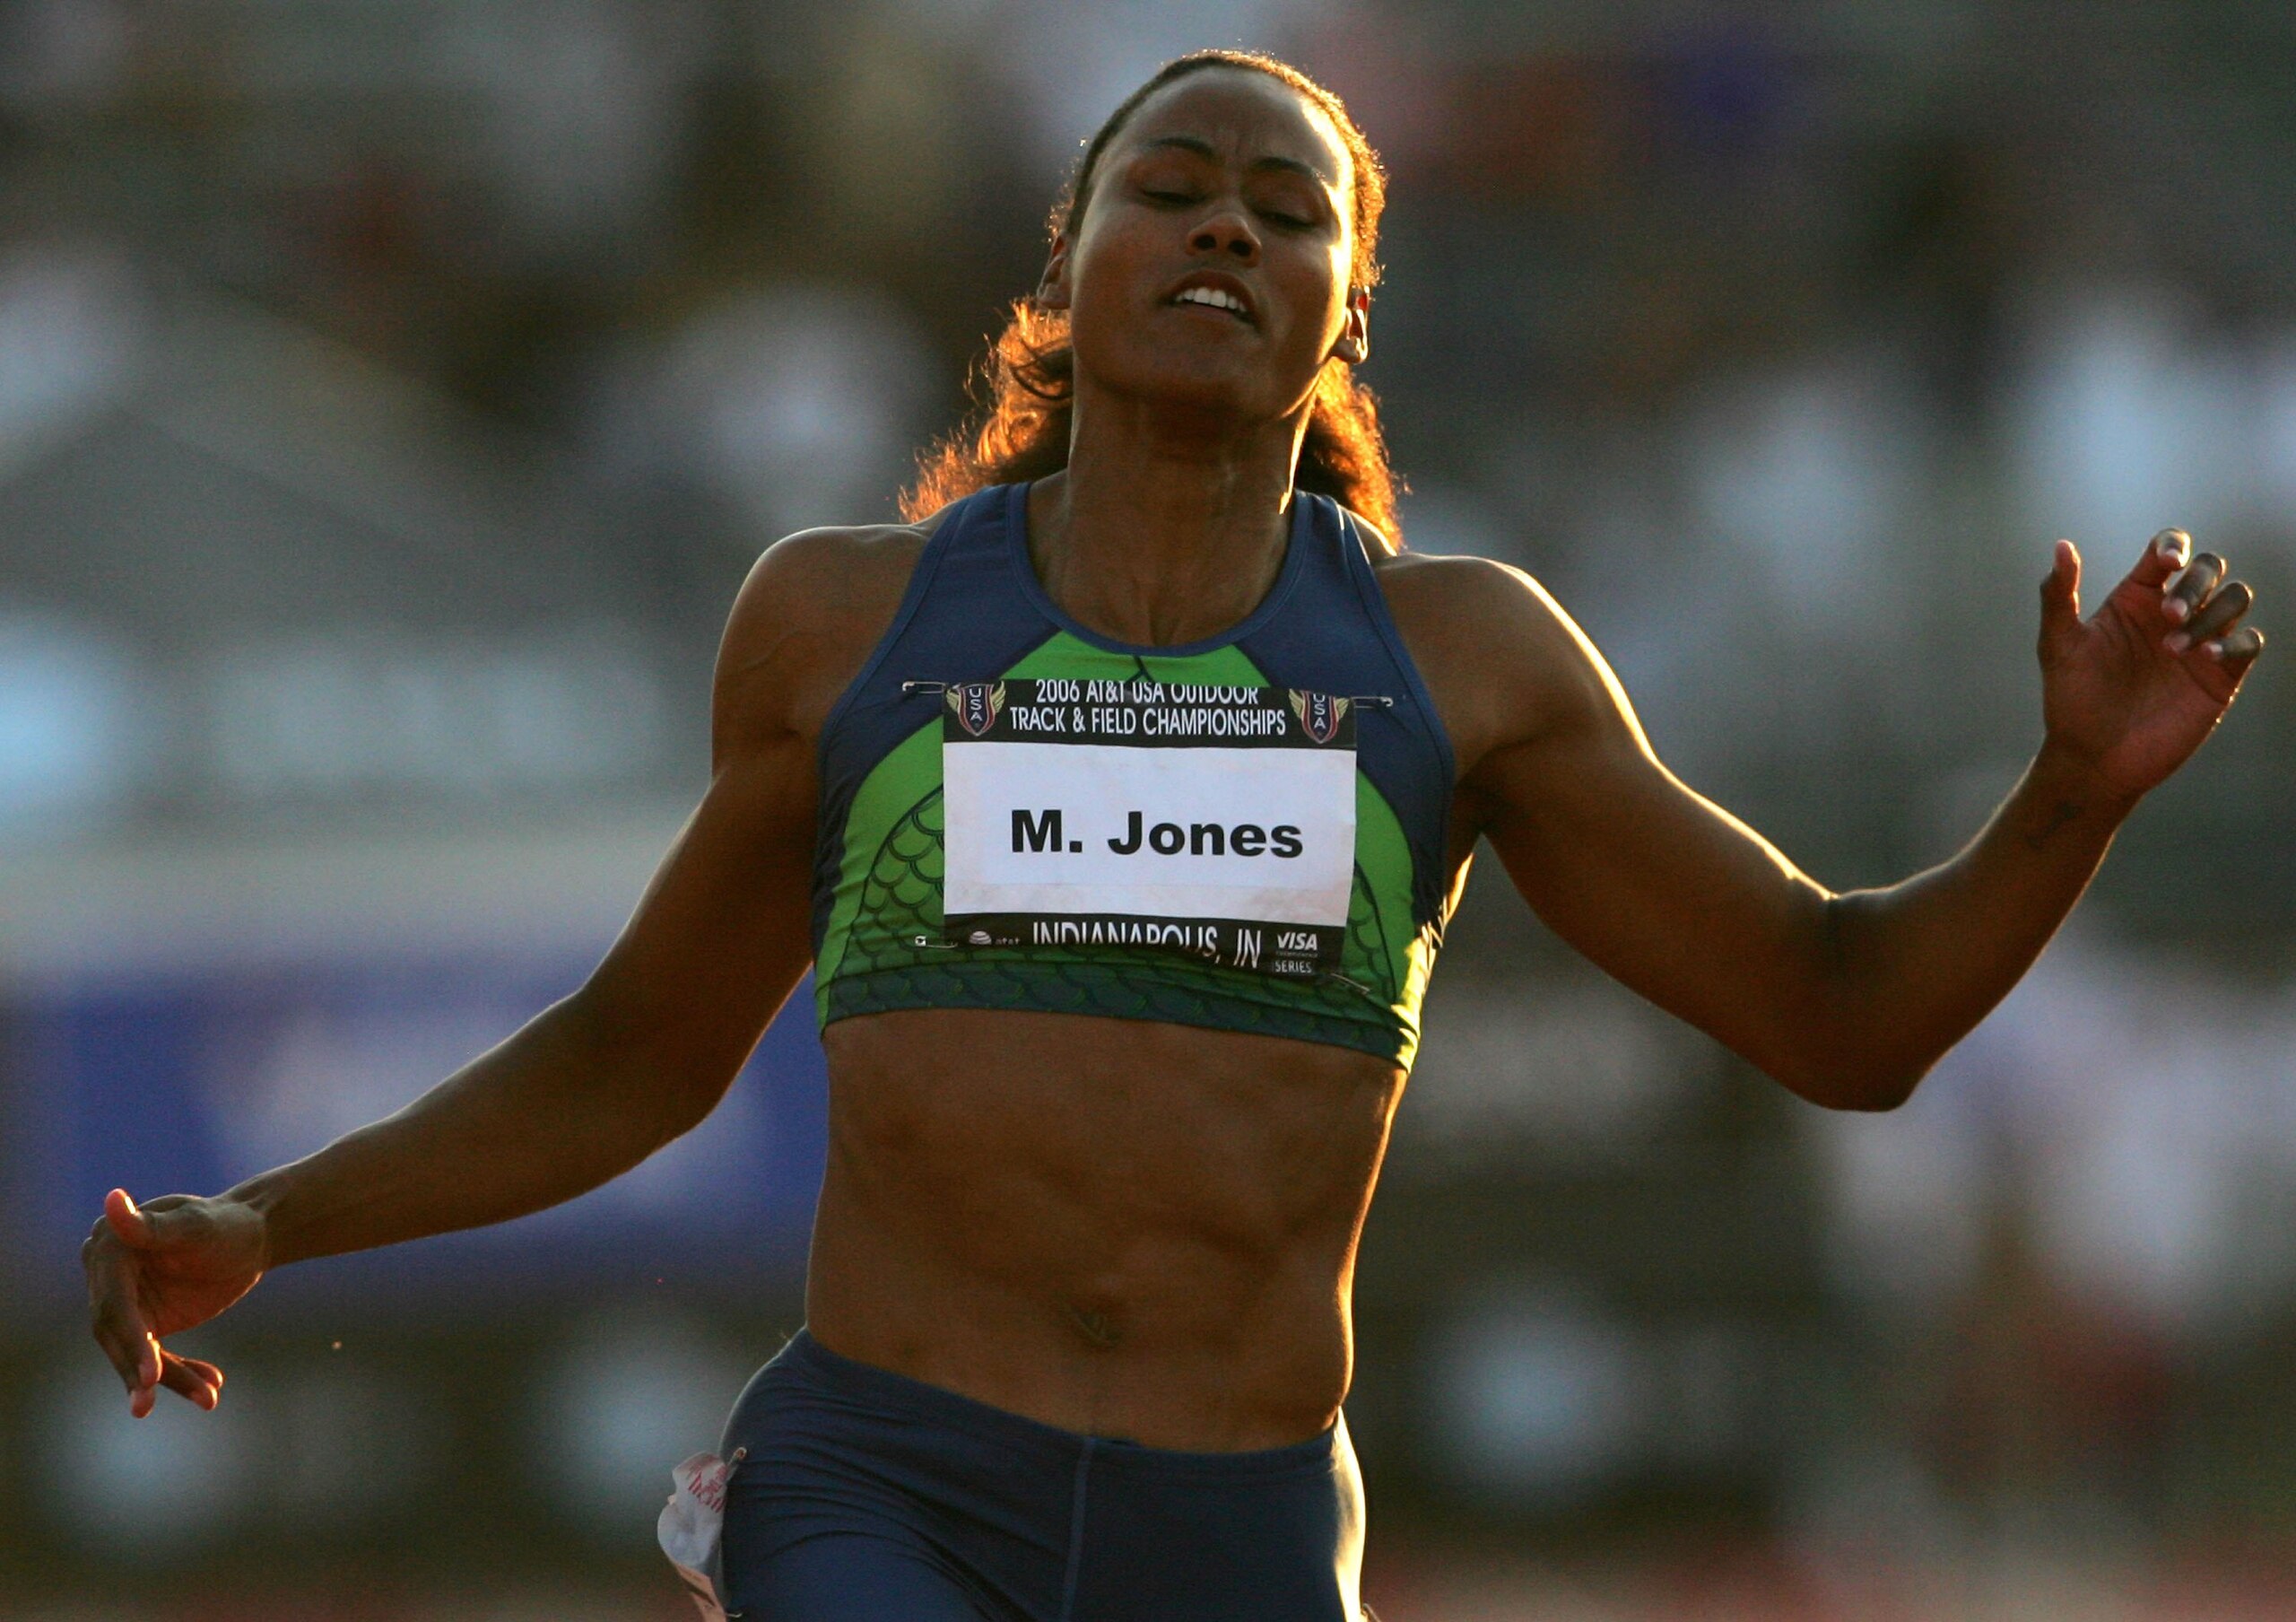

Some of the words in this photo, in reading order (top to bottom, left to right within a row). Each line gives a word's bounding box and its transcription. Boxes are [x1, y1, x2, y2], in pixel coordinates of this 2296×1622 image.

[1036, 679, 1080, 703] 2006
[1085, 679, 1126, 703] AT&T
[1132, 681, 1166, 704] USA
[1170, 683, 1259, 705] OUTDOOR
[1010, 706, 1066, 732] TRACK
[1073, 709, 1086, 733] &
[1091, 707, 1137, 736] FIELD
[1143, 707, 1286, 737] CHAMPIONSHIPS
[1011, 809, 1083, 853] M.
[1107, 810, 1303, 859] Jones
[1233, 928, 1261, 968] IN
[1277, 931, 1318, 951] VISA
[1274, 959, 1313, 974] SERIES
